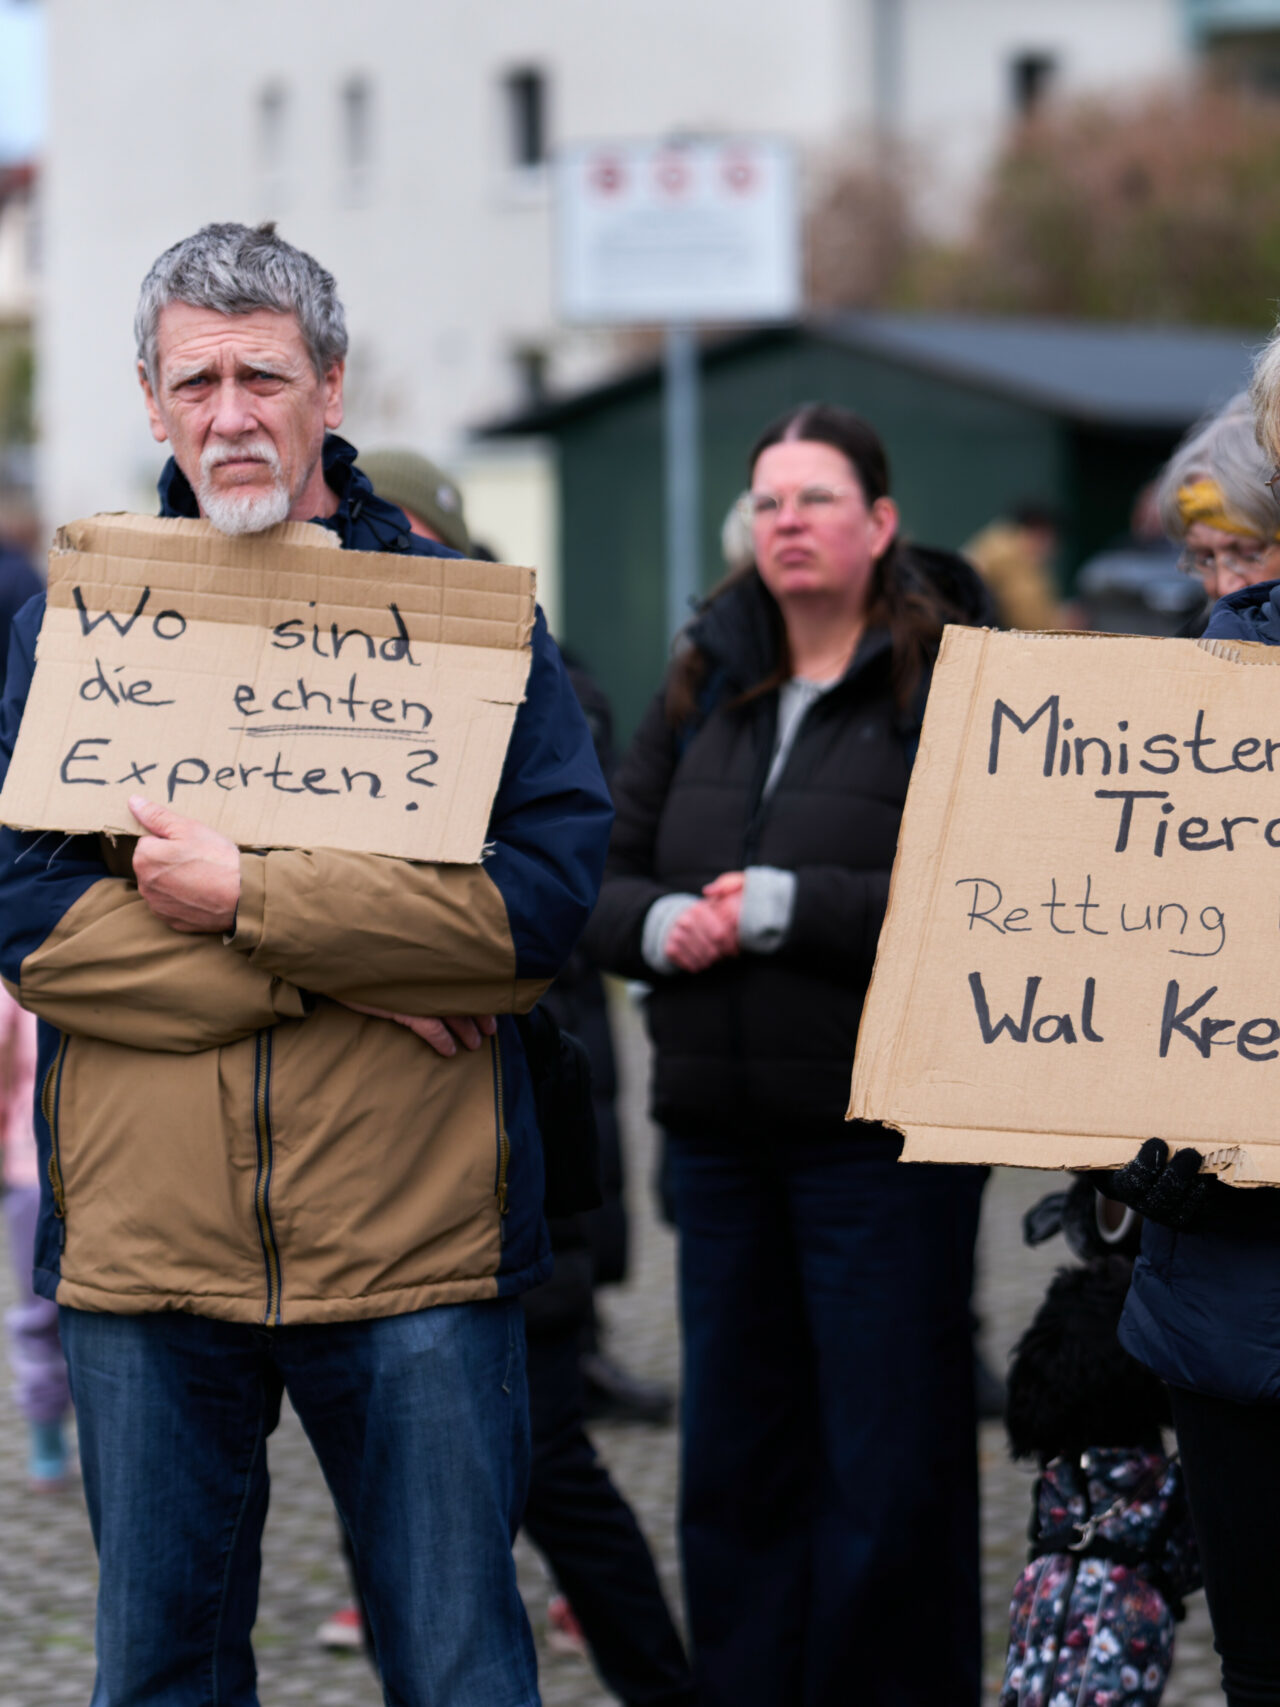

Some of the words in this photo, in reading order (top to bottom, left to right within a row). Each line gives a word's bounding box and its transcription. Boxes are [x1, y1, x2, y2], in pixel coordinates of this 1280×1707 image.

[72, 585, 188, 641] Wo
[271, 601, 421, 667] sind
[79, 658, 175, 707] die
[233, 672, 433, 730] echten
[60, 738, 440, 812] Experten?
[955, 874, 1226, 957] Rettung
[967, 971, 1105, 1045] Wal
